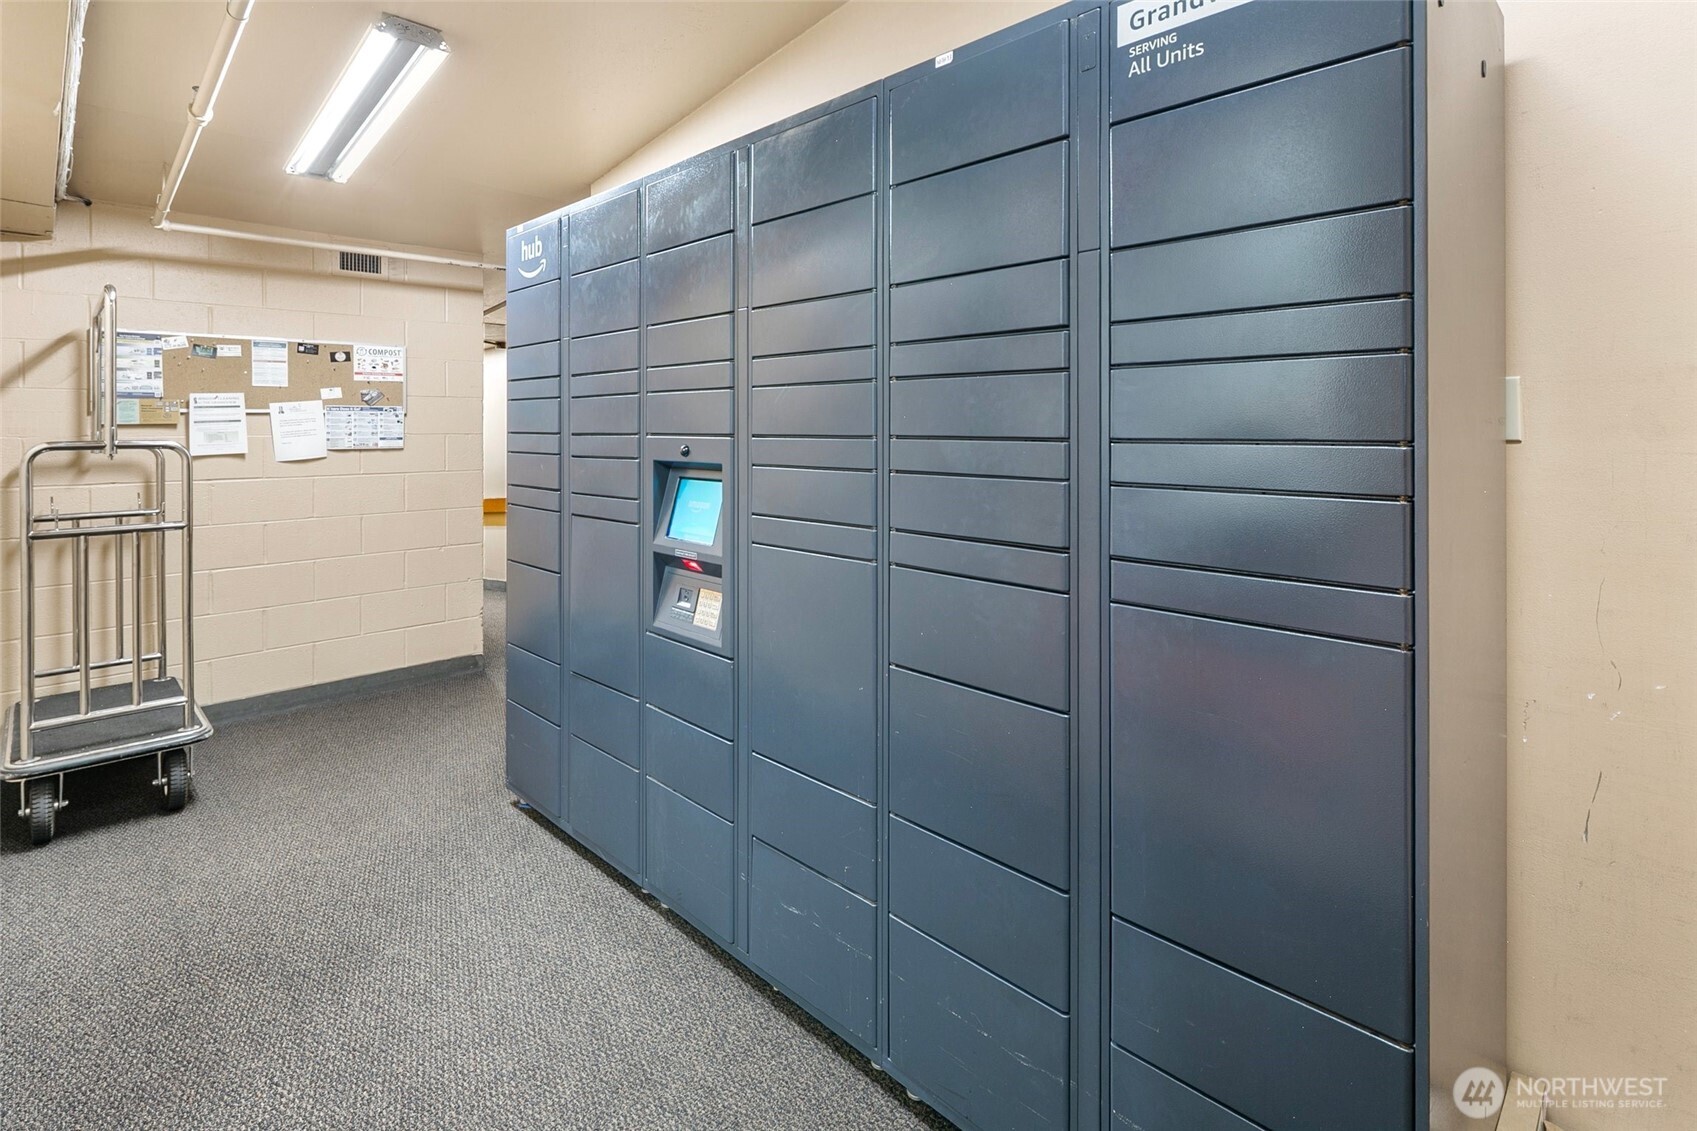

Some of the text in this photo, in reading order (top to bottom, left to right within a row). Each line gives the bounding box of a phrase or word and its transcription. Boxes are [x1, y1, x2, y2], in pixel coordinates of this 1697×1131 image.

[1130, 0, 1216, 30] Gran
[1129, 33, 1177, 57] SERVING
[1128, 42, 1204, 78] All Units
[521, 235, 543, 261] hub
[368, 348, 400, 356] COMPOST
